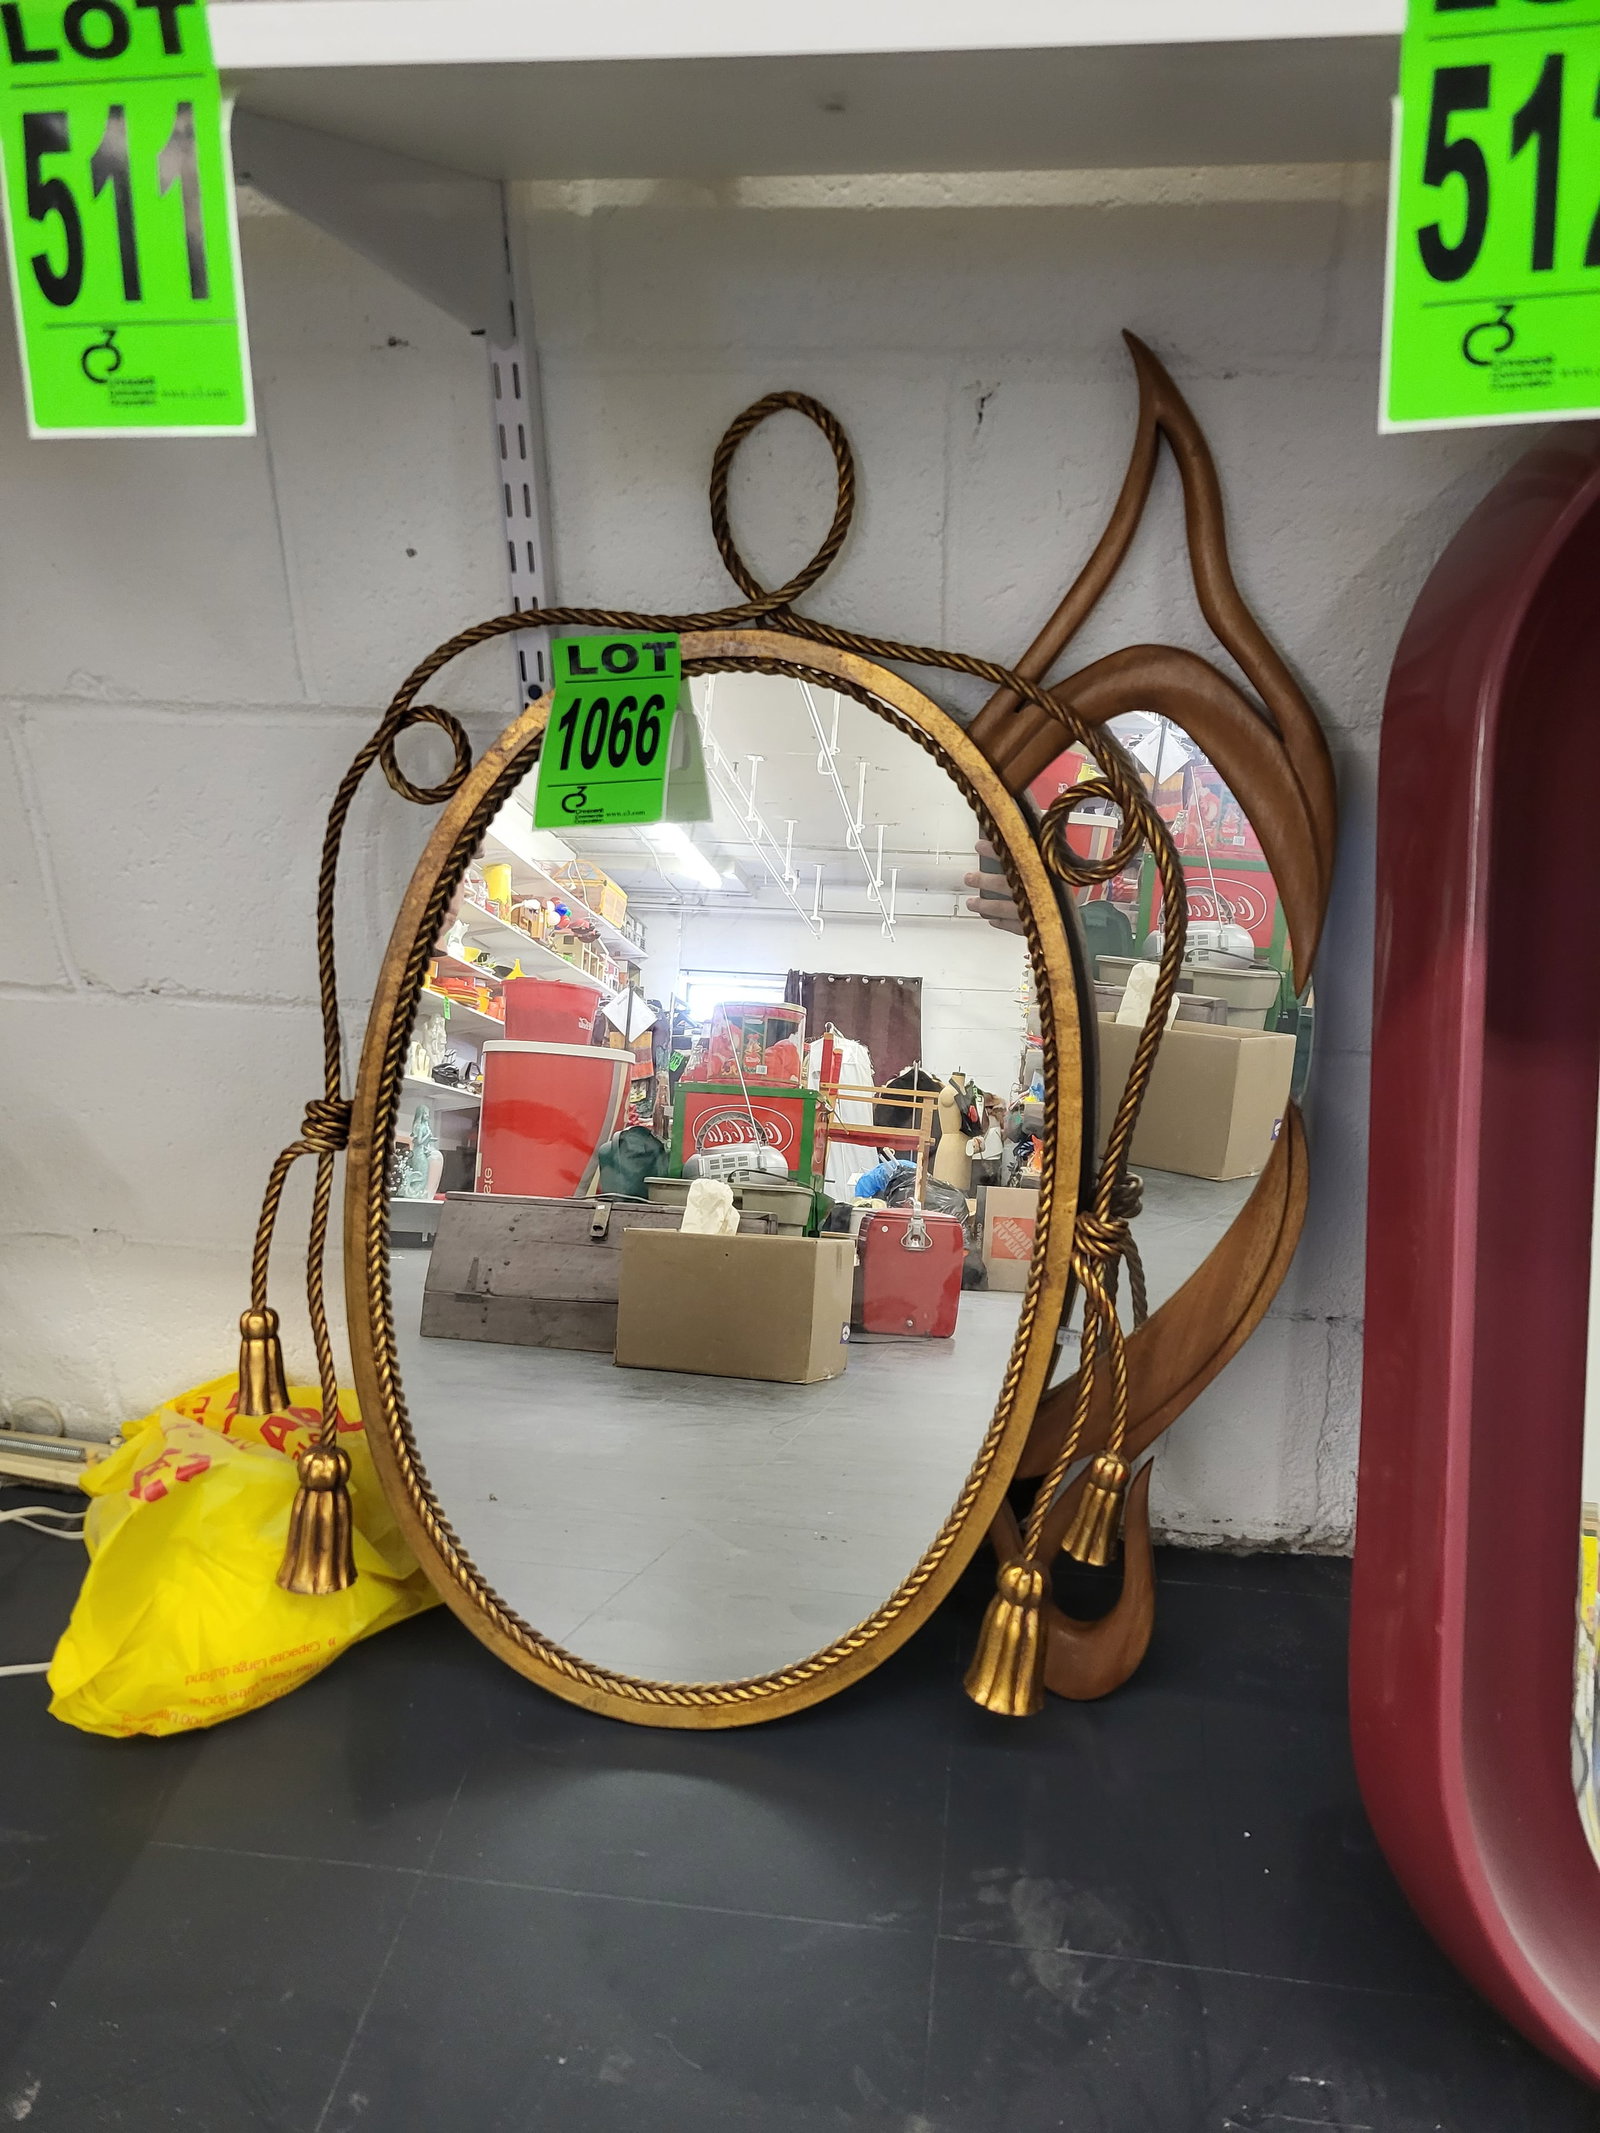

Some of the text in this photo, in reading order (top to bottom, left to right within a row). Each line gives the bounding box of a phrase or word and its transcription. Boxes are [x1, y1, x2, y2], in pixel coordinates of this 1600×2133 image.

[2, 0, 196, 64] LOT
[23, 101, 209, 307] 511
[567, 641, 677, 676] LOT
[558, 694, 665, 771] 1066
